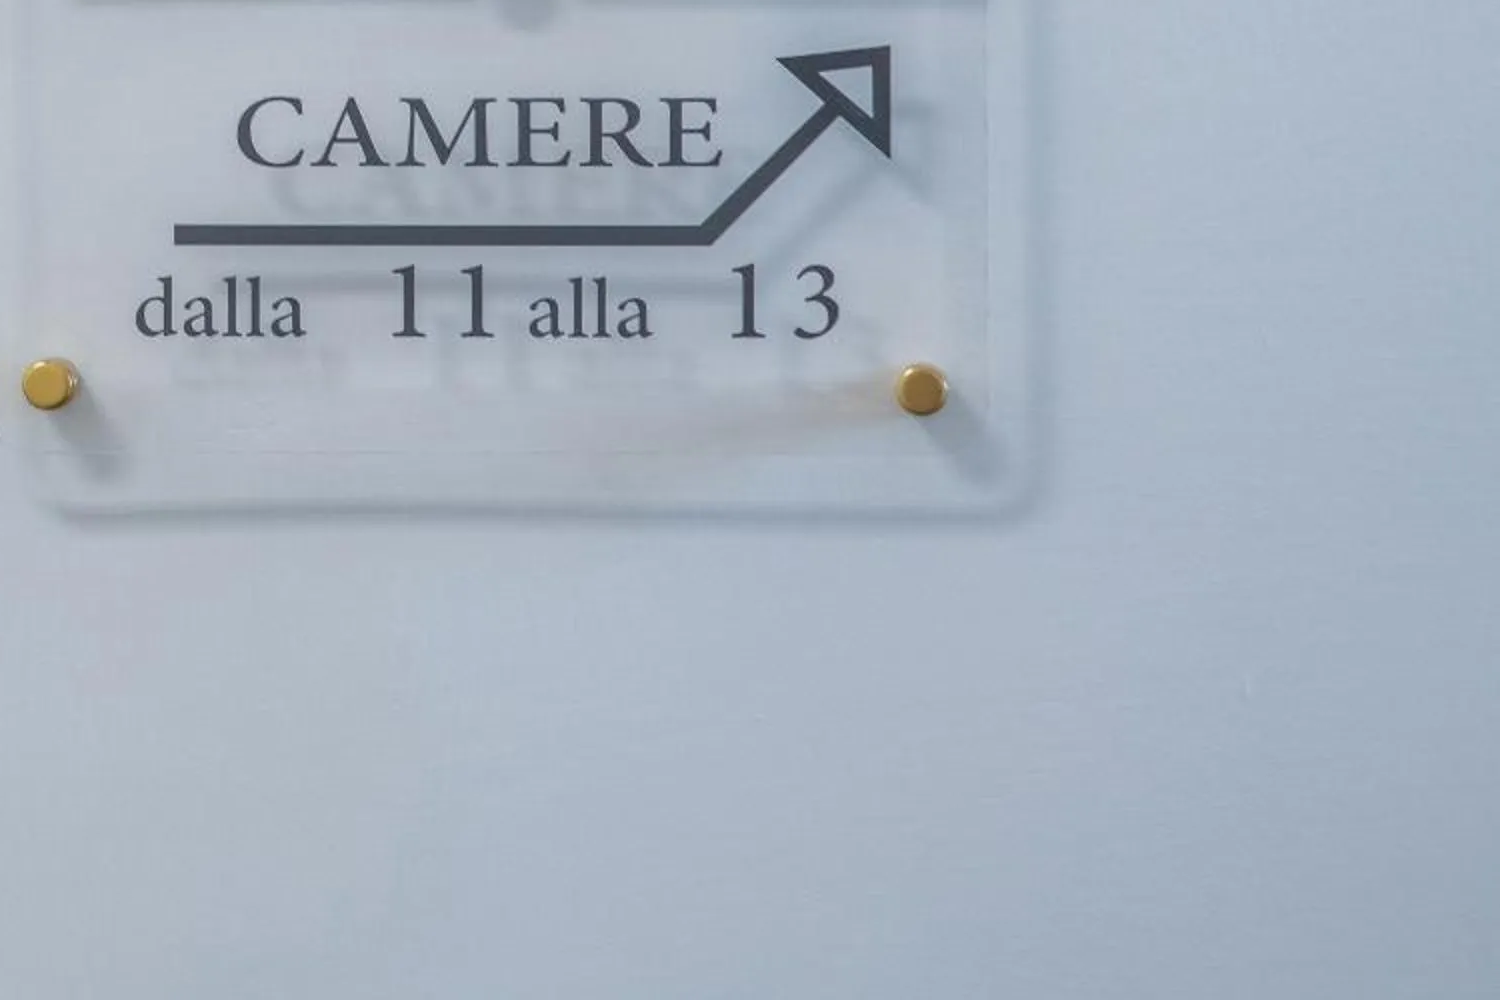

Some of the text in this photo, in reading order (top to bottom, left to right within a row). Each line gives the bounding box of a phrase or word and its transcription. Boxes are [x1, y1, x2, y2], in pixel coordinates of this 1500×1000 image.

[237, 96, 723, 168] CAMERE
[135, 263, 840, 340] dalla 11 alla 13
